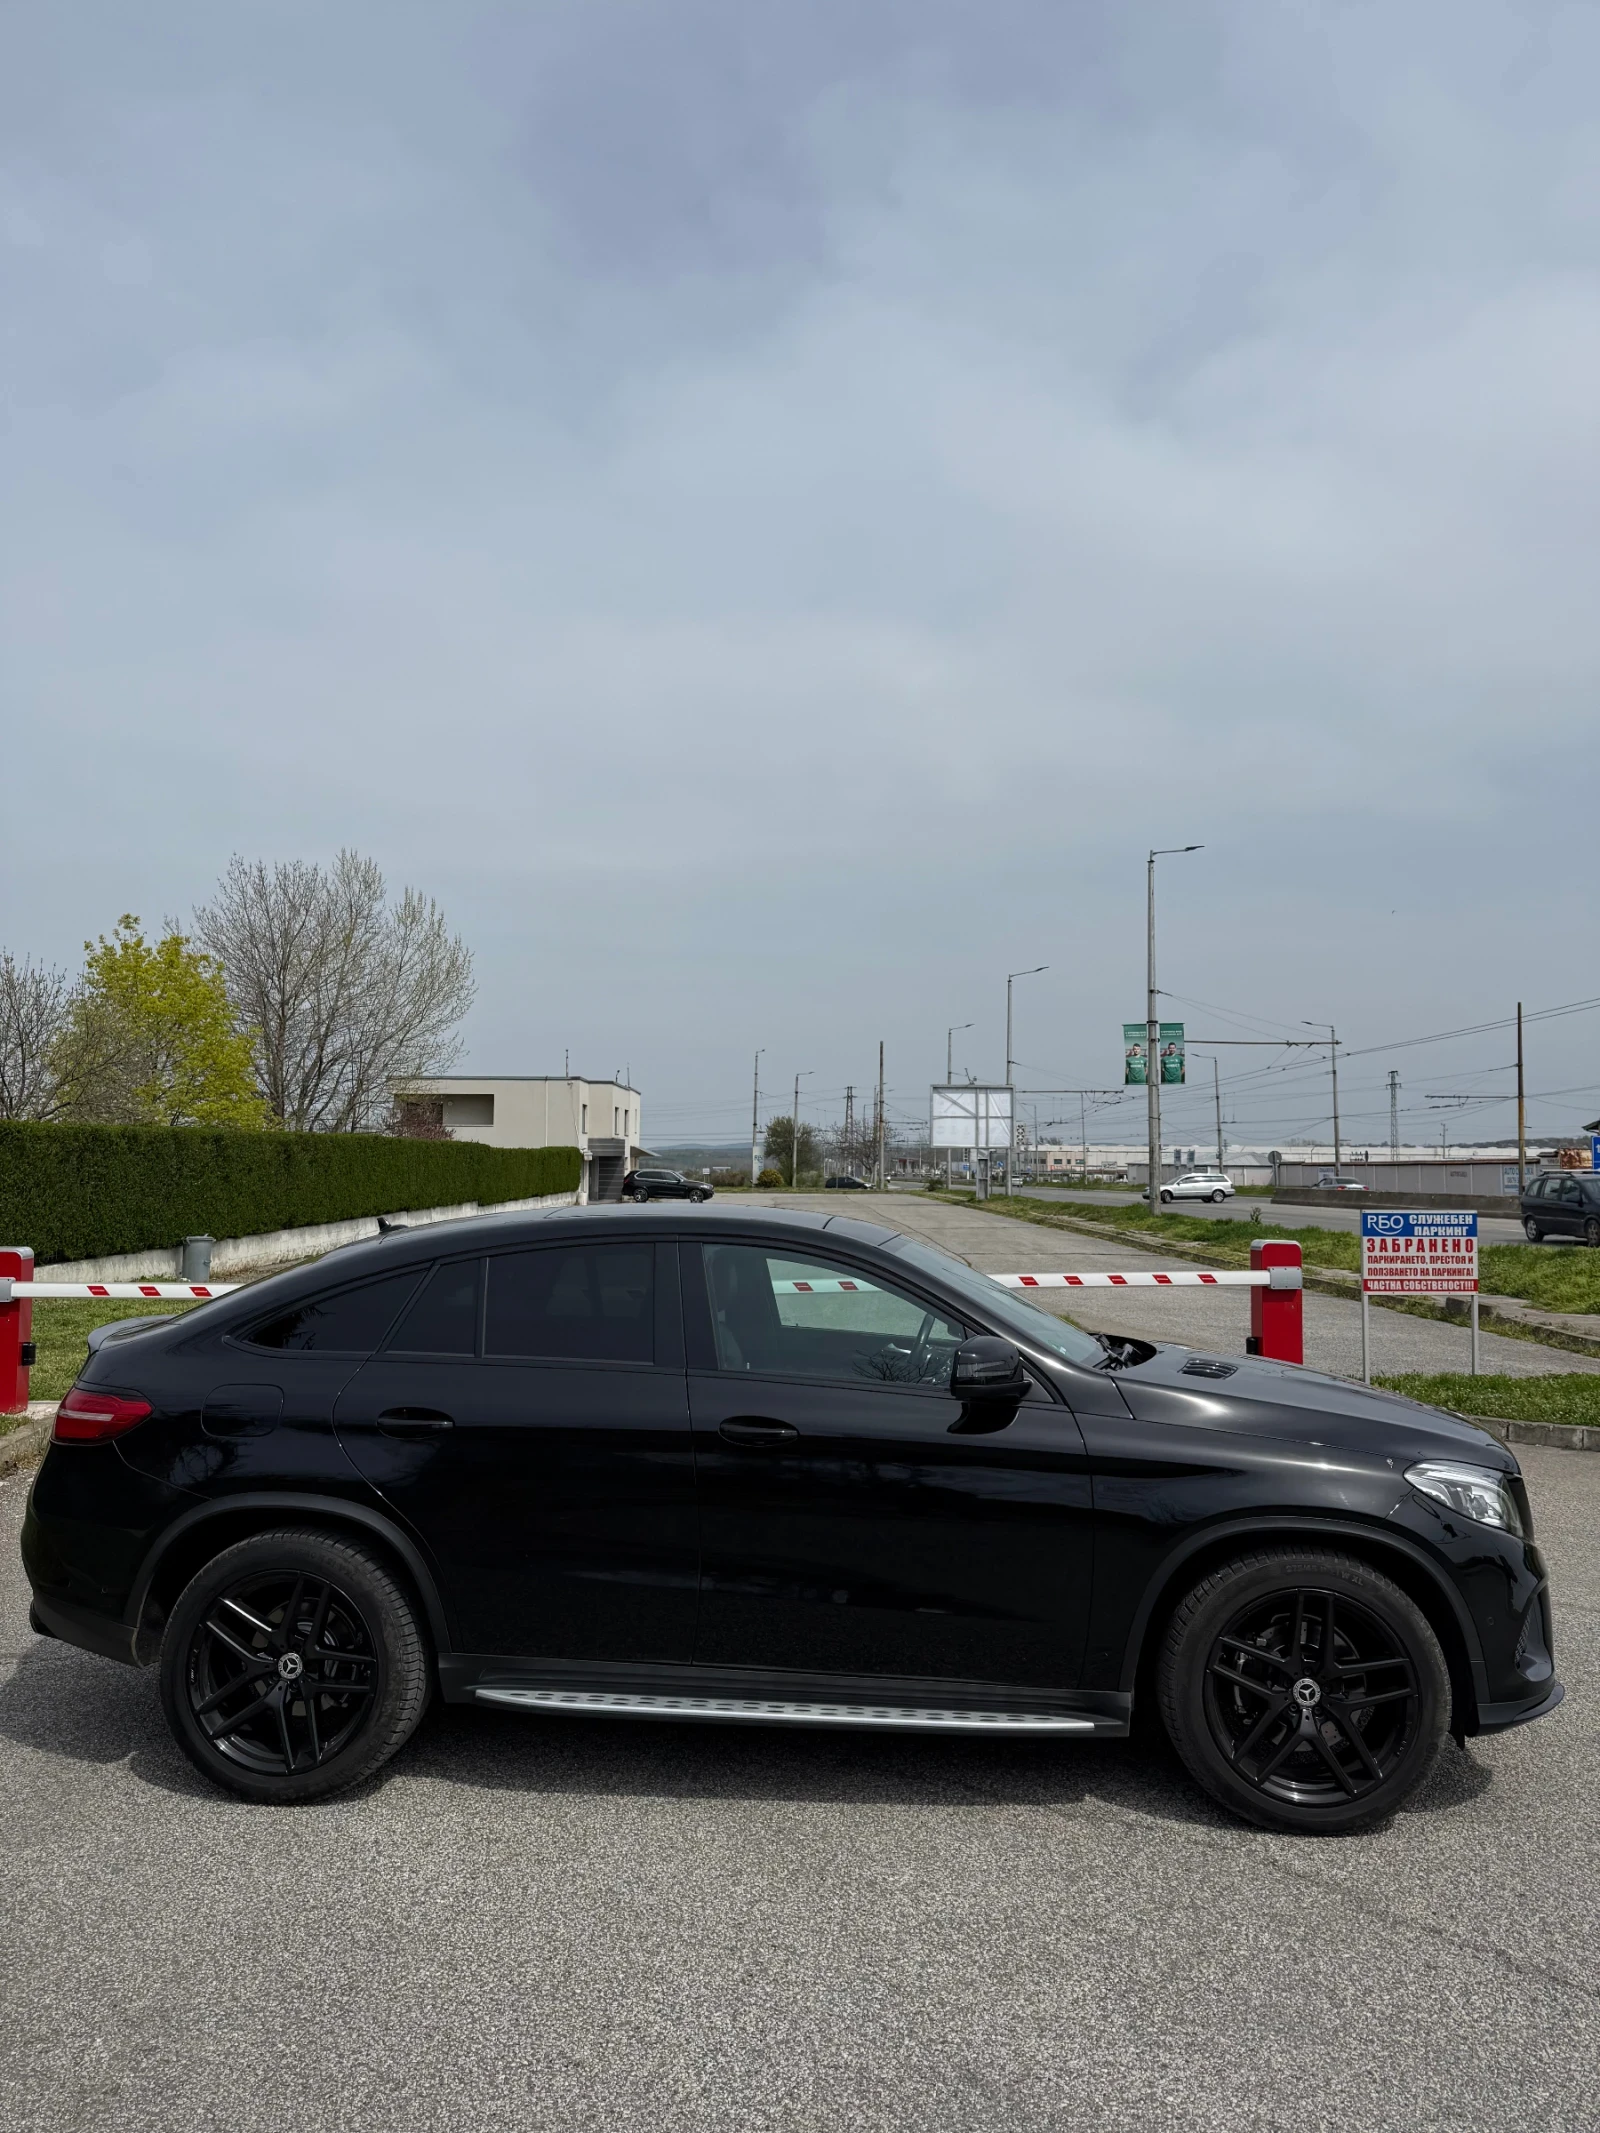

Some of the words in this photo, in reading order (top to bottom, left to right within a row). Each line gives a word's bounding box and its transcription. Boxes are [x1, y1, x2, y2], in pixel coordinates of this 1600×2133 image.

[1409, 1214, 1473, 1225] СЛУЖЕБЕН
[1414, 1226, 1469, 1236] ПАРКИНГ
[1366, 1238, 1474, 1253] ЗАБРАНЕНО
[1367, 1255, 1428, 1265] ПАРКИРАНЕТО,
[1429, 1255, 1466, 1265] ПРЕСТОЯ
[1468, 1255, 1474, 1265] И
[1367, 1267, 1418, 1277] ПОЛЗВАНЕТО
[1420, 1267, 1430, 1277] НА
[1431, 1267, 1474, 1277] ПАРКИНГА!
[1367, 1280, 1402, 1290] ЧАСТНА
[1403, 1280, 1475, 1290] СОБСТВЕНОСТ!!!
